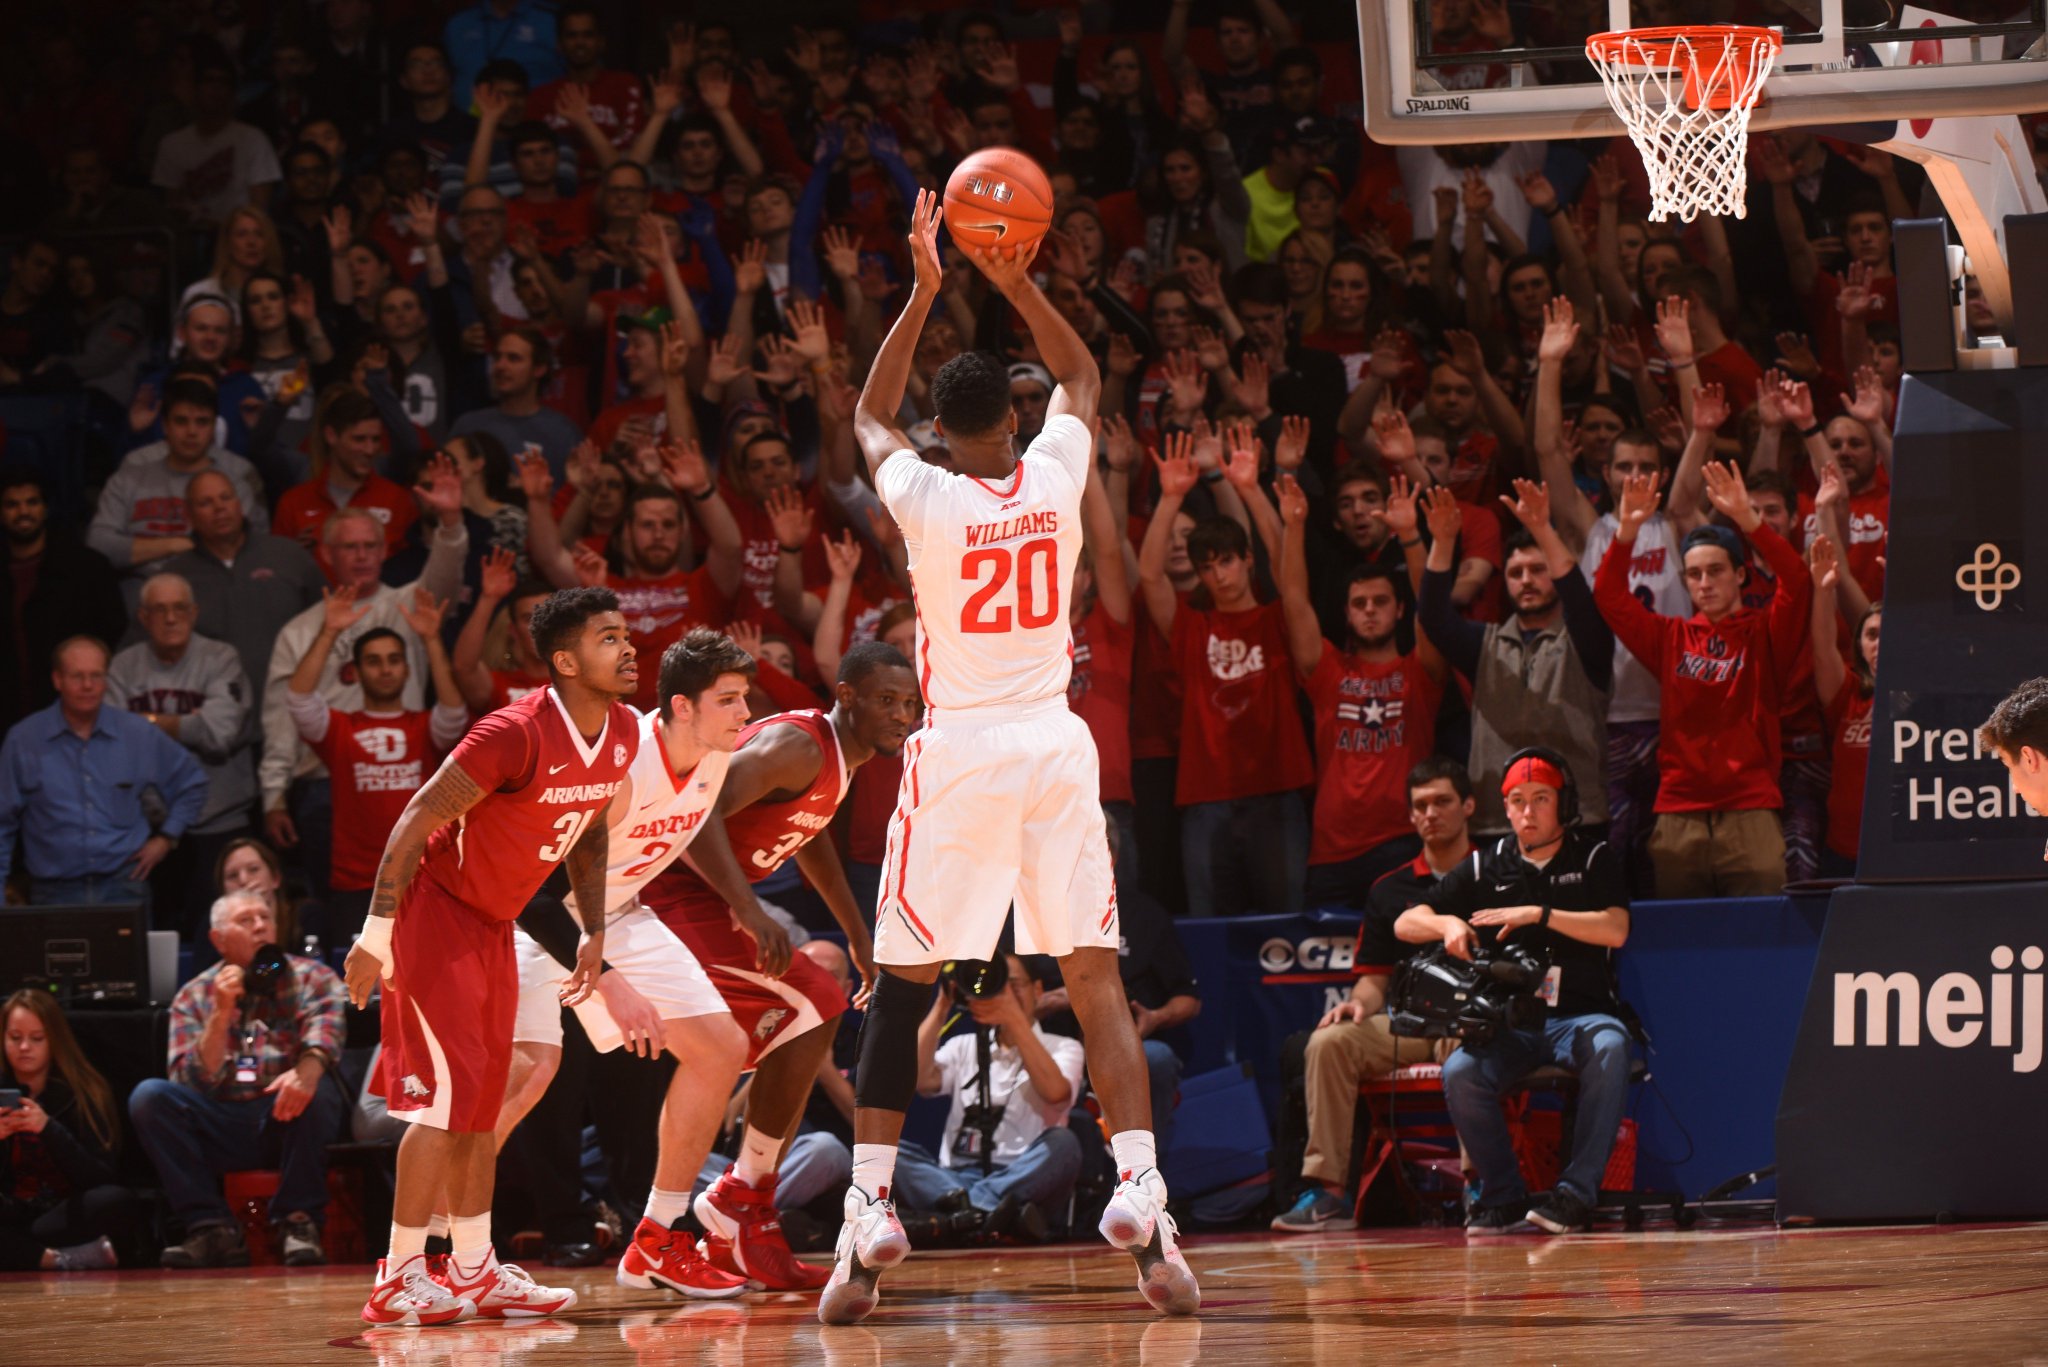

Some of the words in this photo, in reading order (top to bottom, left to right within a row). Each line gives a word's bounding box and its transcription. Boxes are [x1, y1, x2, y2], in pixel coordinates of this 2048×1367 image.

[1406, 96, 1470, 114] SPALDING
[965, 511, 1058, 547] WILLIAMS
[960, 537, 1059, 633] 20
[1336, 720, 1406, 753] ARMY
[353, 760, 422, 779] DAYTON
[356, 777, 421, 793] FLYERS
[622, 841, 672, 877] 2
